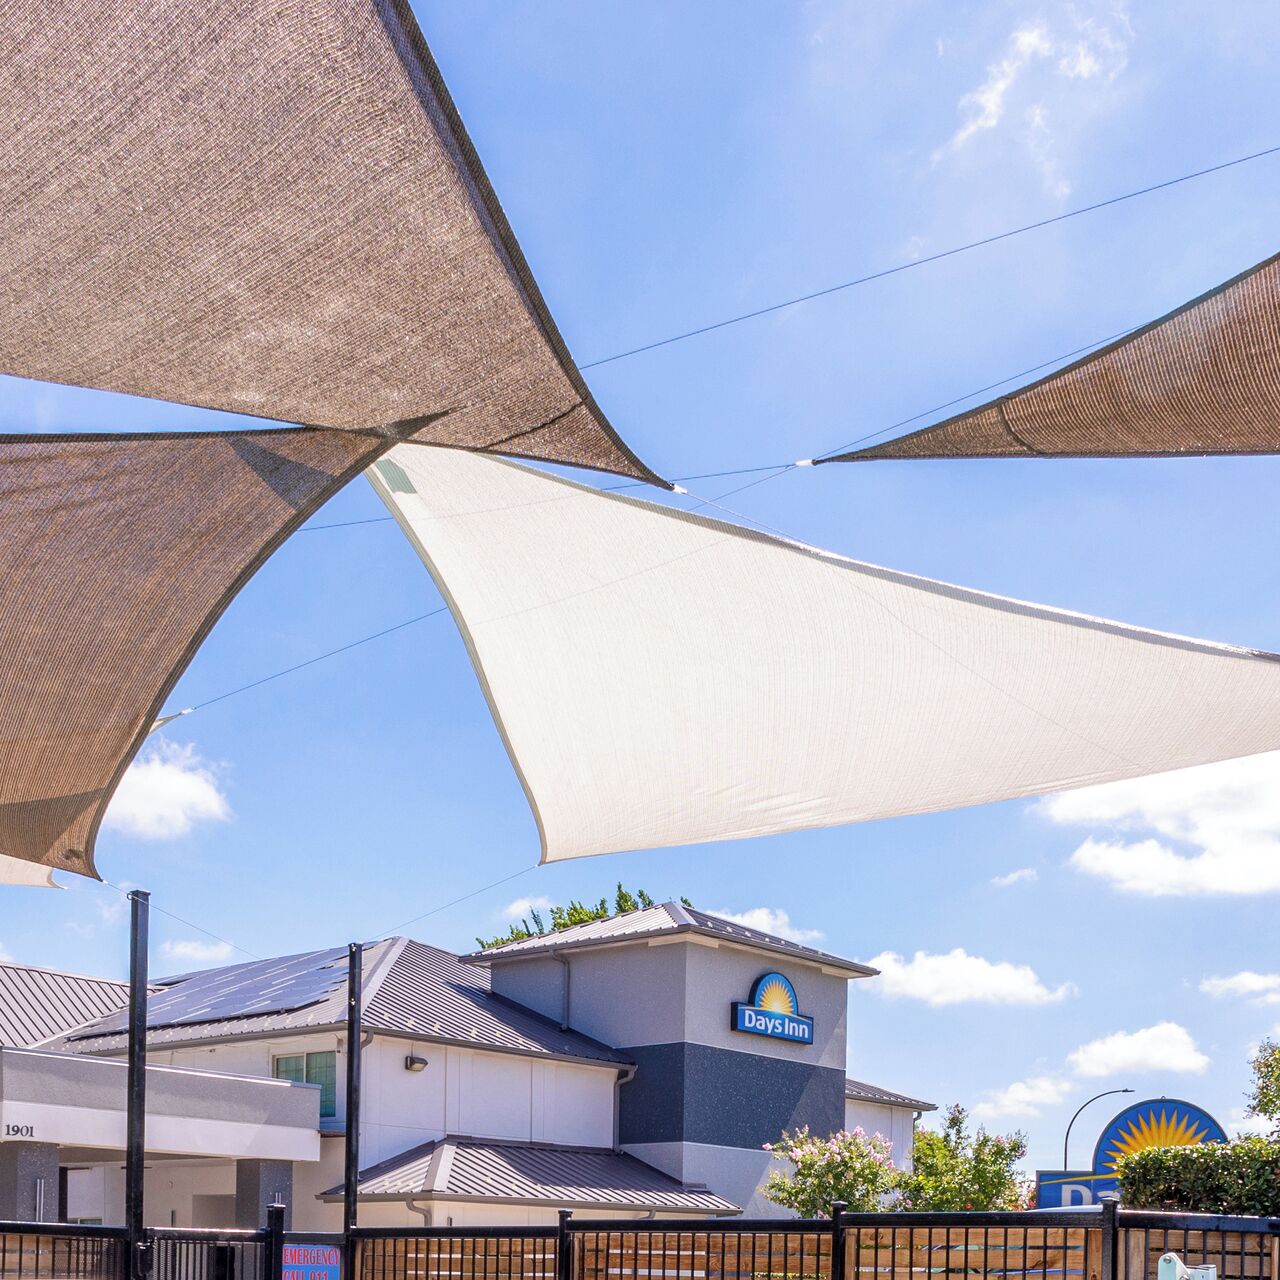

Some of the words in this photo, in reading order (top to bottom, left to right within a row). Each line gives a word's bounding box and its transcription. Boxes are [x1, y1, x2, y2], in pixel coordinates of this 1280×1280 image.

[744, 1009, 783, 1034] Days
[784, 1017, 809, 1039] Inn
[5, 1124, 35, 1138] 1901
[283, 1247, 339, 1266] EMERGENCY
